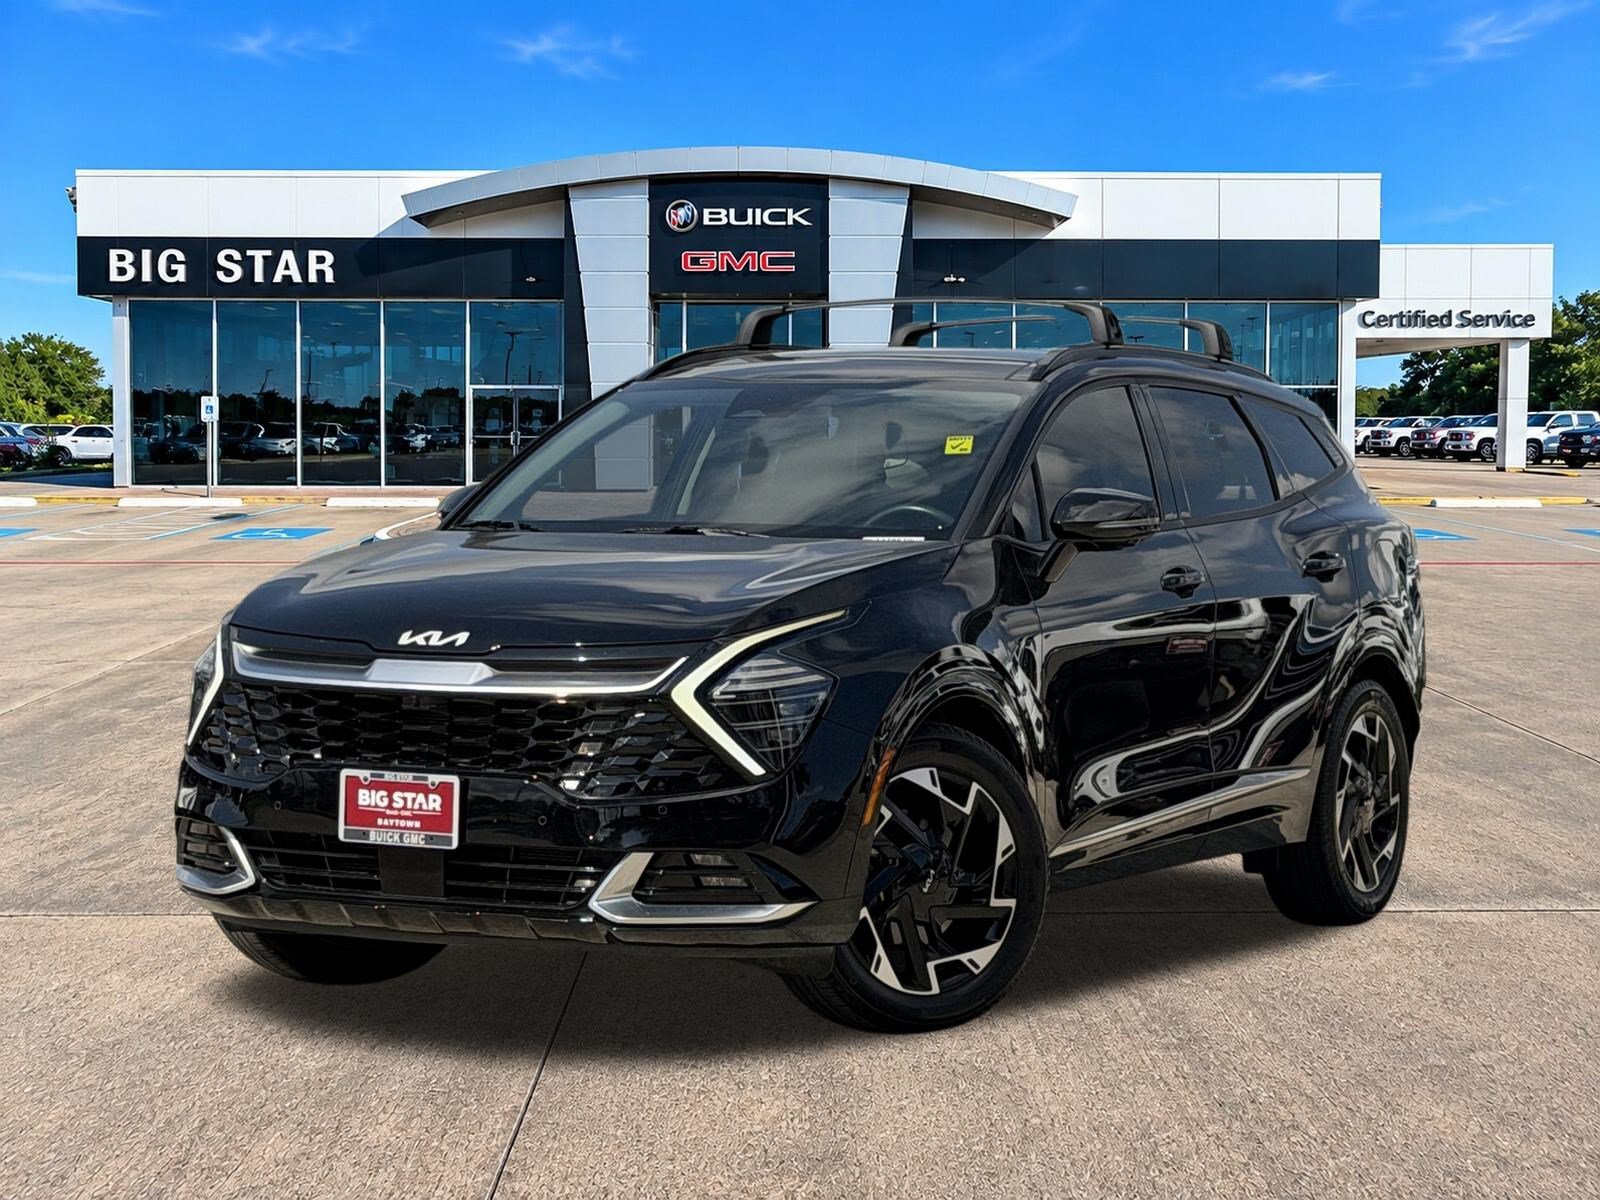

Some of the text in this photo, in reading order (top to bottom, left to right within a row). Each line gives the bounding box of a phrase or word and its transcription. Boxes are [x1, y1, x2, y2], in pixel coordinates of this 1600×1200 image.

[703, 208, 813, 226] BUICK
[109, 249, 335, 283] BIG STAR
[681, 251, 795, 271] GMC
[1360, 309, 1536, 328] Certified Service
[358, 789, 442, 811] BIG STAR
[377, 818, 421, 828] BAYTOWN
[369, 831, 426, 844] BUICK GMC
